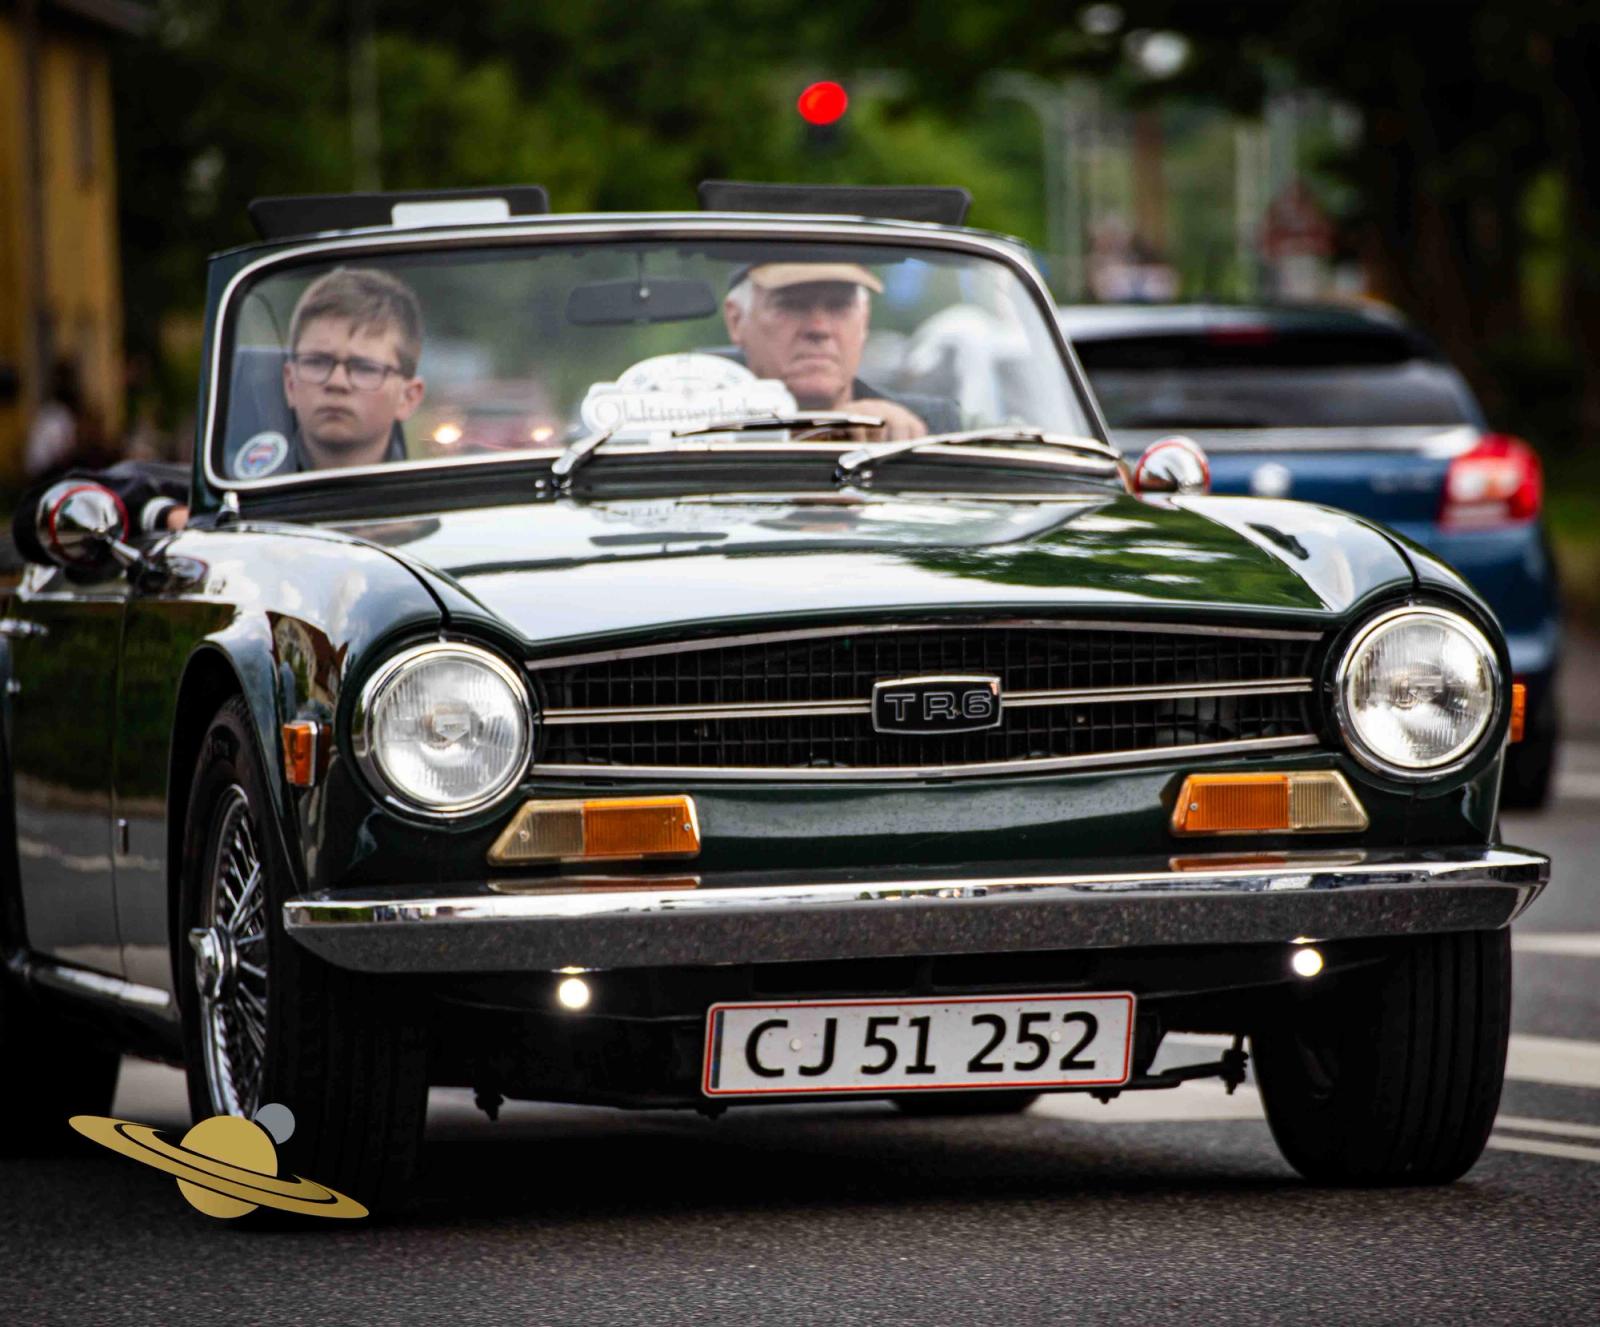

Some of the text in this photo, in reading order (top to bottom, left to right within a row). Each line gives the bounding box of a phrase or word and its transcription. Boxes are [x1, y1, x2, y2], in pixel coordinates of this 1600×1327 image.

[884, 690, 992, 721] TR6
[744, 1011, 1099, 1078] CJ 51 252
